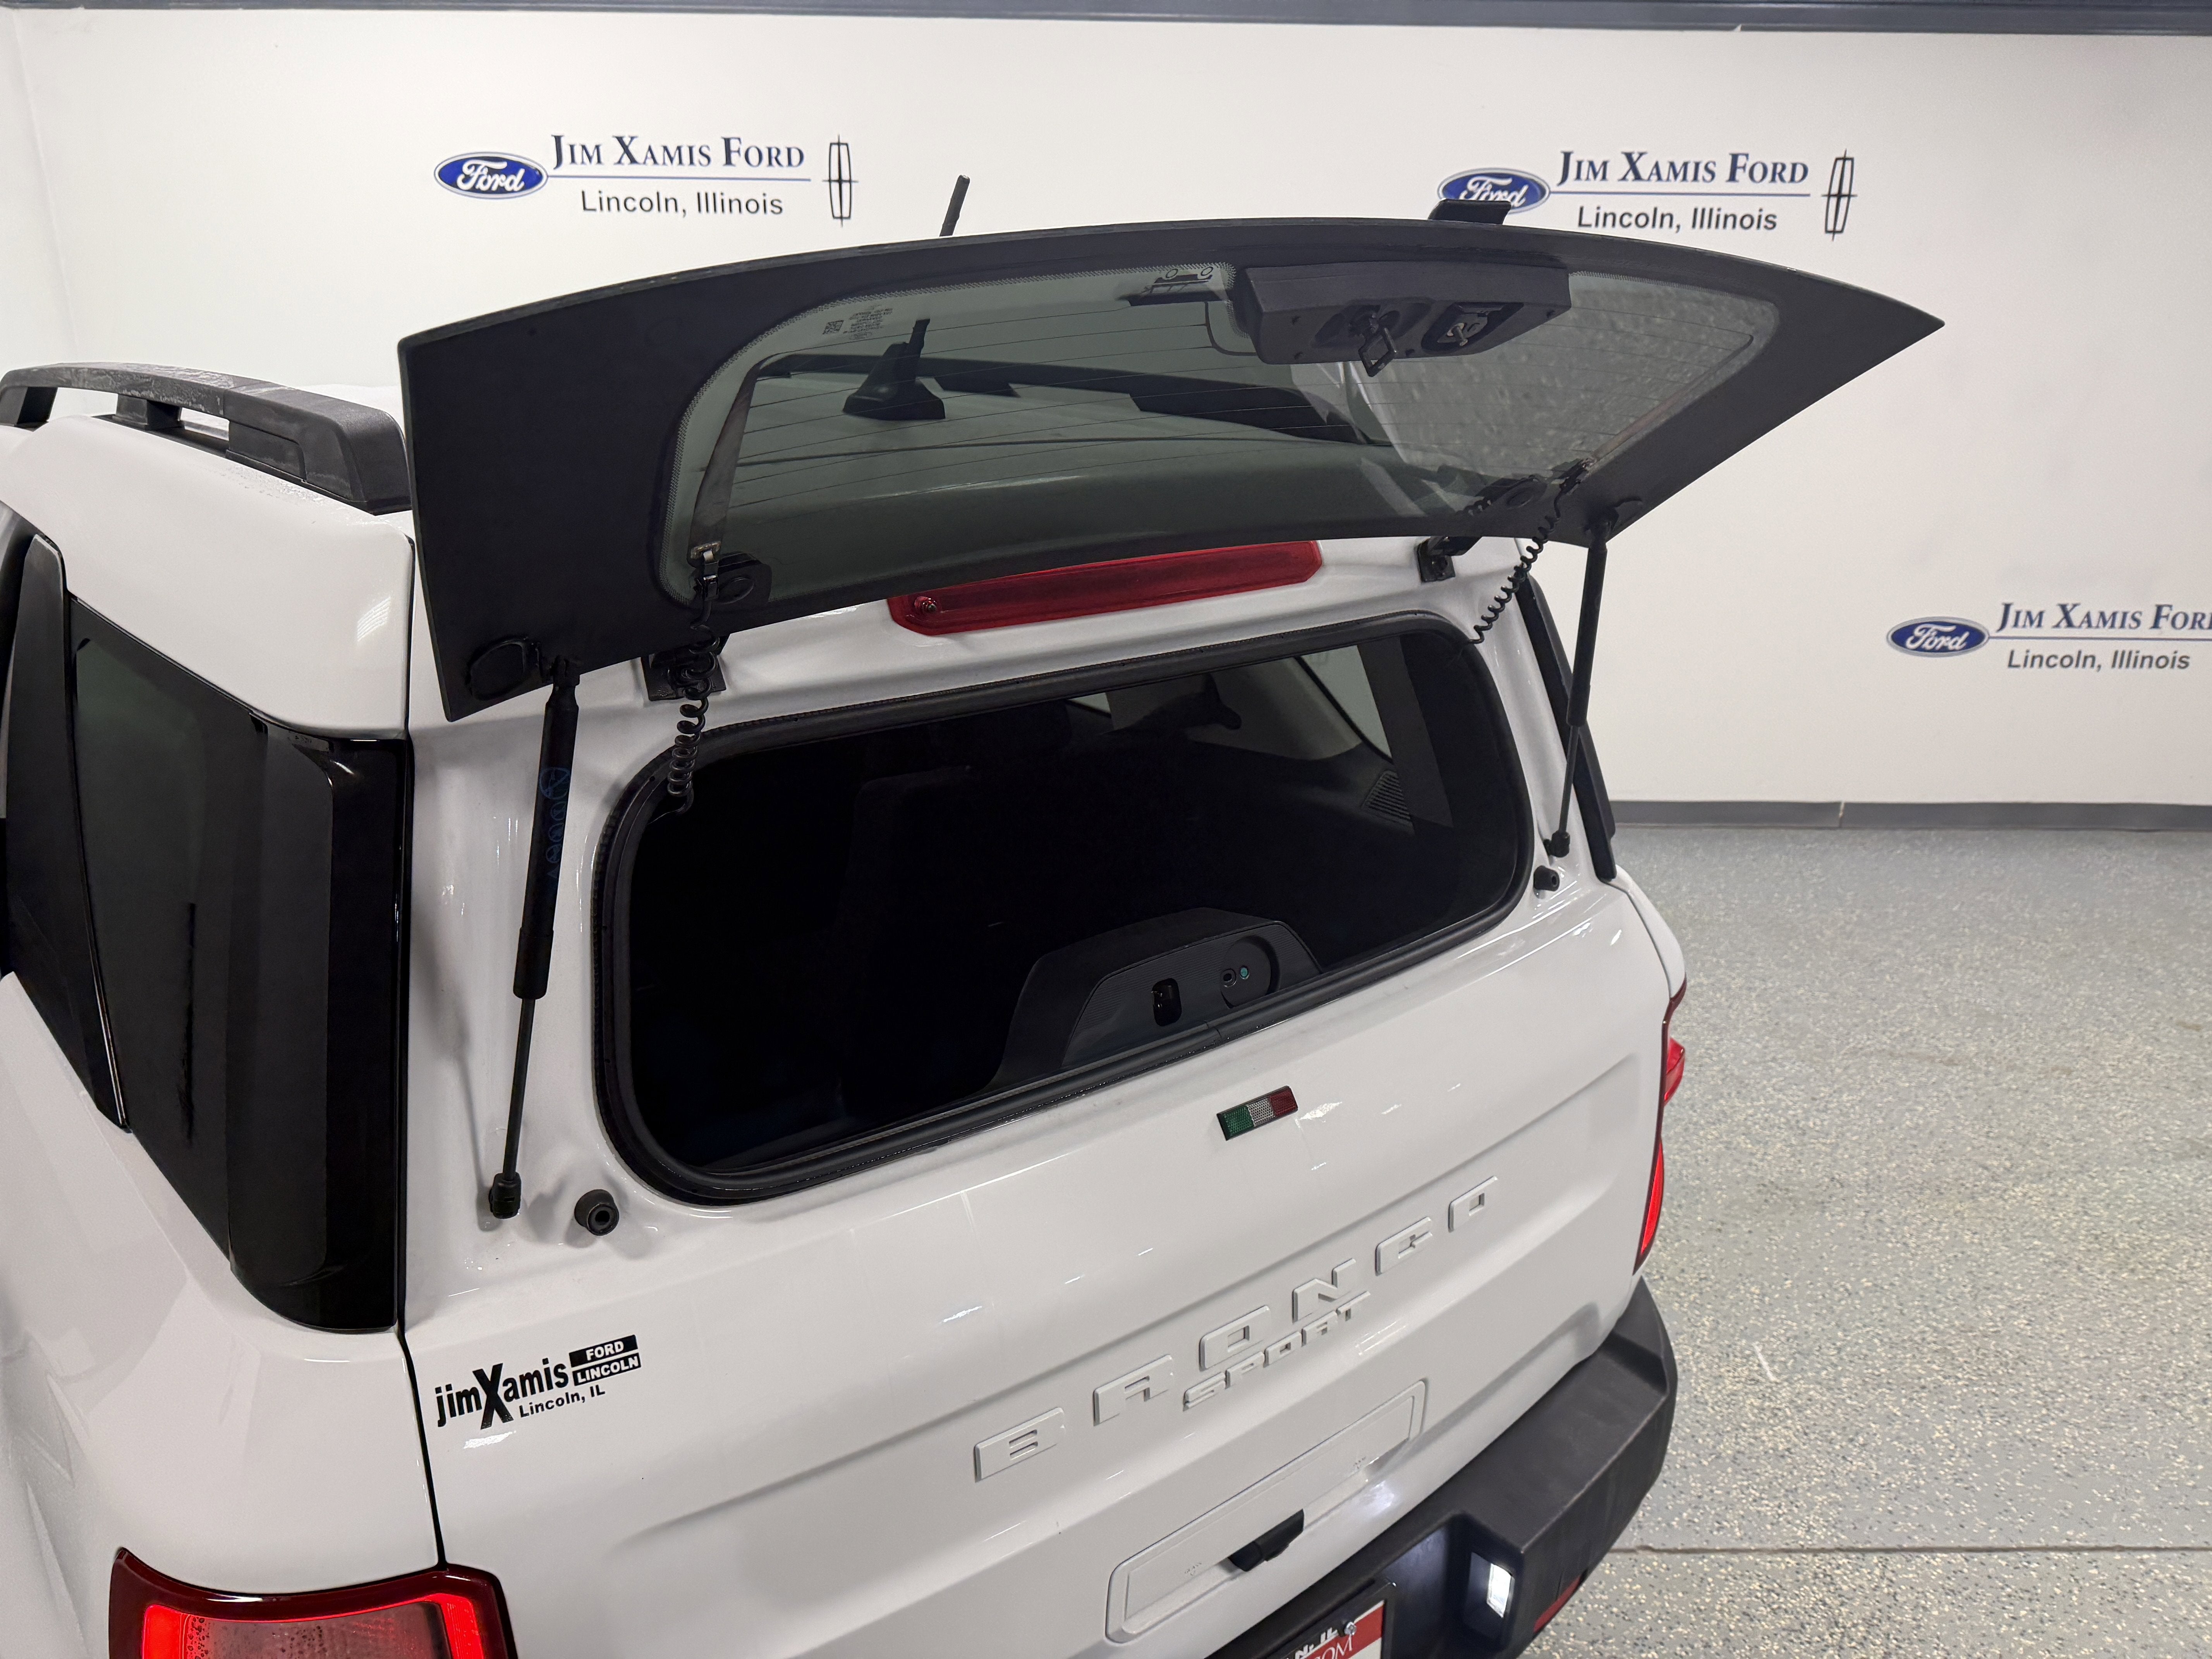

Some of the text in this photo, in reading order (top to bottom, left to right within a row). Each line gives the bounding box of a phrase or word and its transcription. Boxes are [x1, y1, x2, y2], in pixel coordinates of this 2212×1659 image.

[457, 160, 525, 191] Ford
[582, 190, 783, 217] Lincoln, Illinois
[1578, 206, 1777, 232] Lincoln, Illinois
[2149, 604, 2212, 630] FOR
[1905, 623, 1967, 651] Ford
[2008, 649, 2190, 672] Lincoln, Illinois
[974, 1176, 1498, 1482] BRONCO
[586, 1341, 624, 1361] FORD
[1183, 1291, 1371, 1411] SPORT
[577, 1356, 639, 1383] LINCOLN
[519, 1384, 605, 1417] Lincoln, IL
